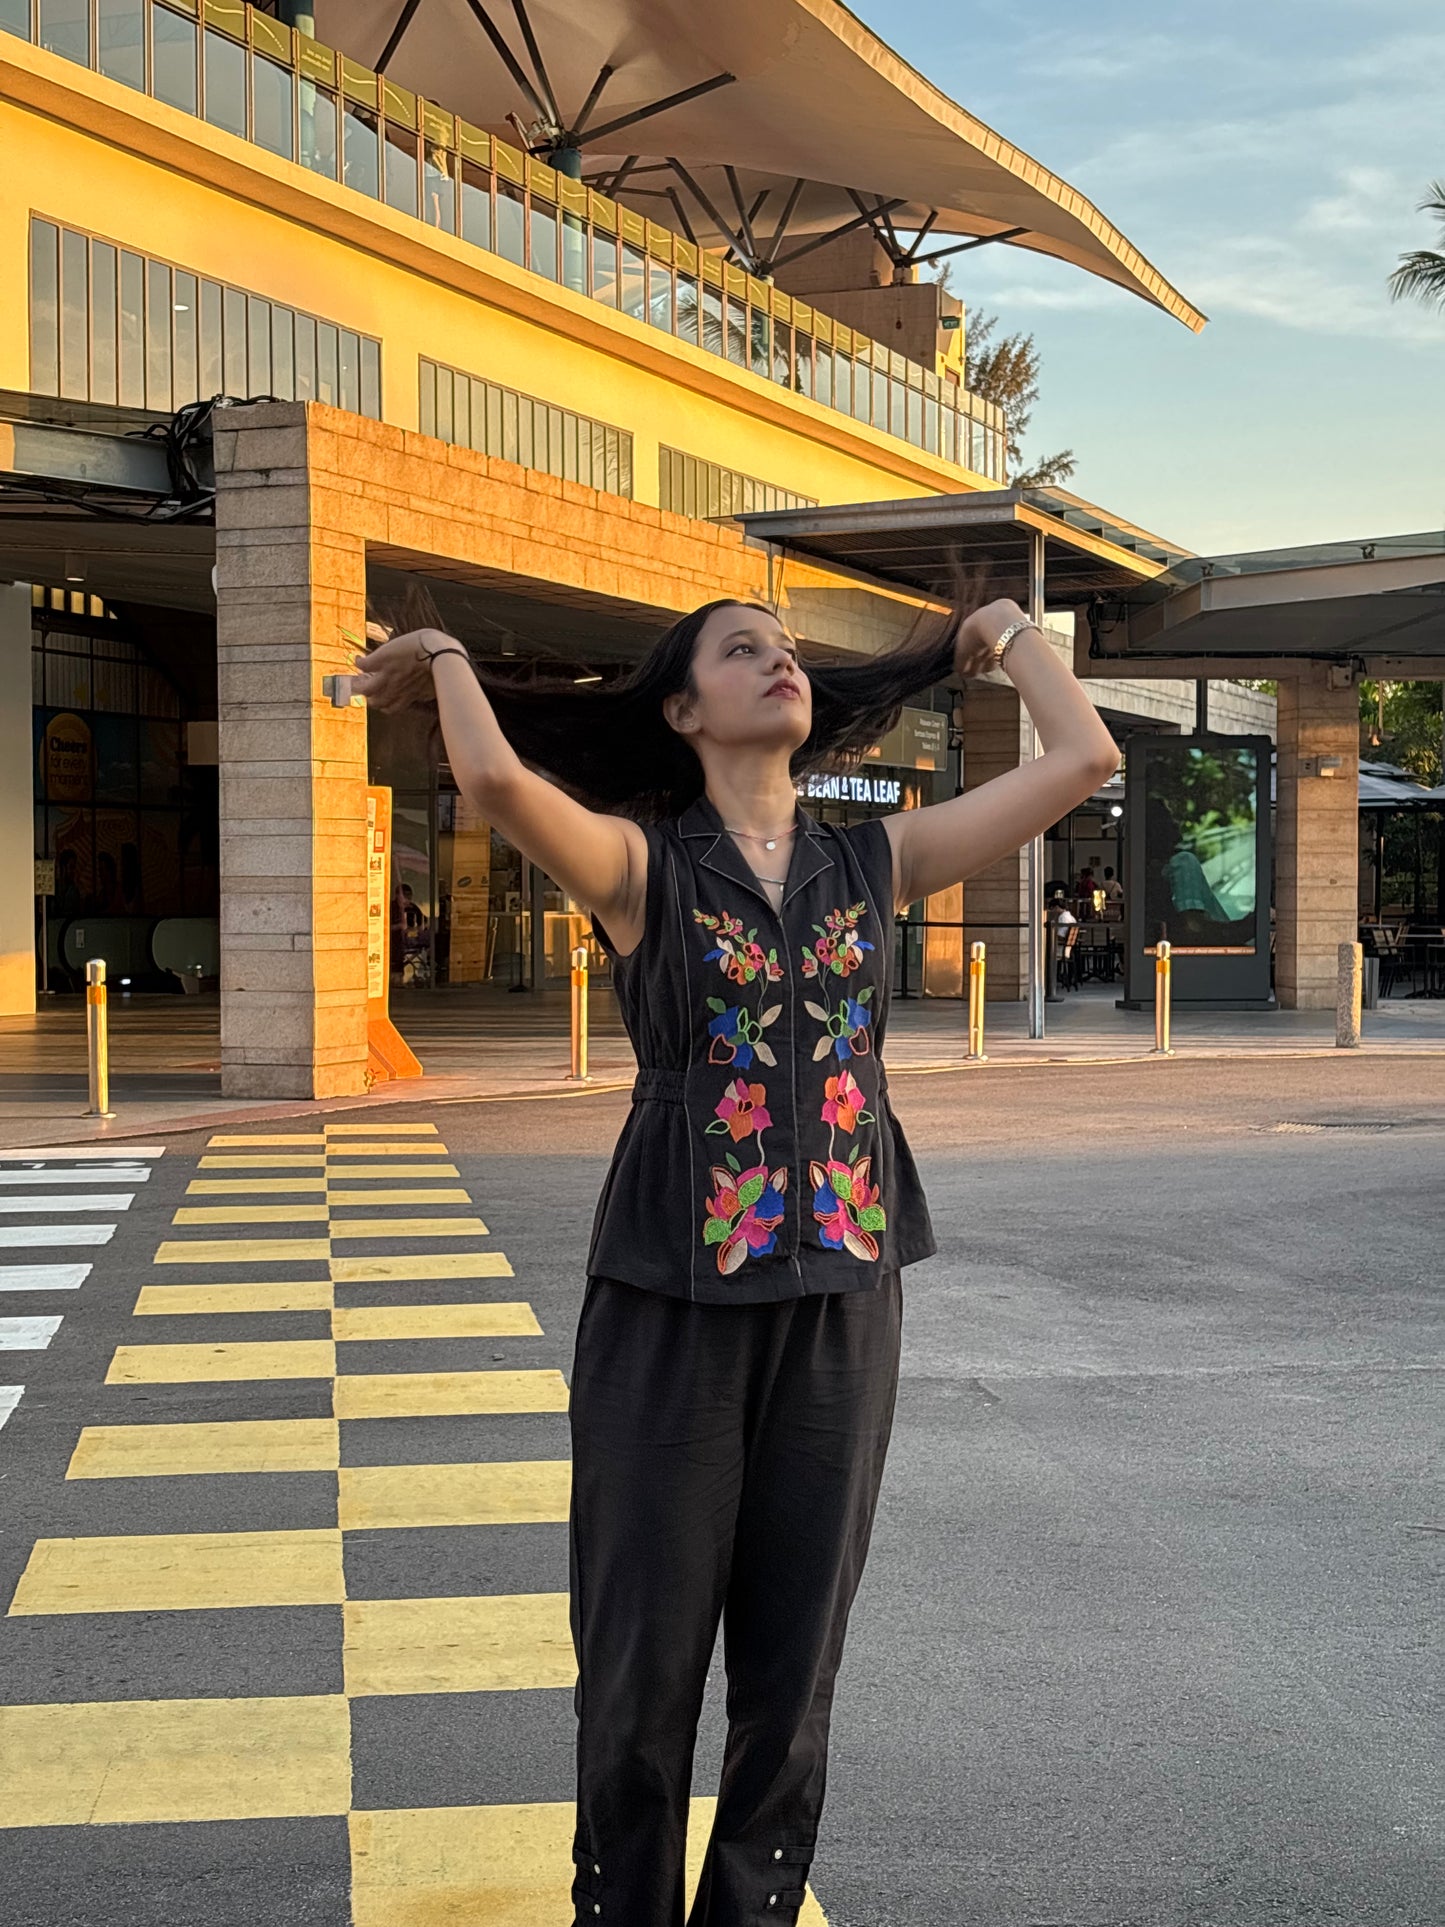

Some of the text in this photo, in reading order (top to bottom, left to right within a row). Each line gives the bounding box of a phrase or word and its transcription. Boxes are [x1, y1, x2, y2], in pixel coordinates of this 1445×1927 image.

[51, 736, 87, 754] Cheers
[841, 777, 849, 798] &
[849, 777, 872, 802] TEA
[873, 779, 901, 804] LEAF
